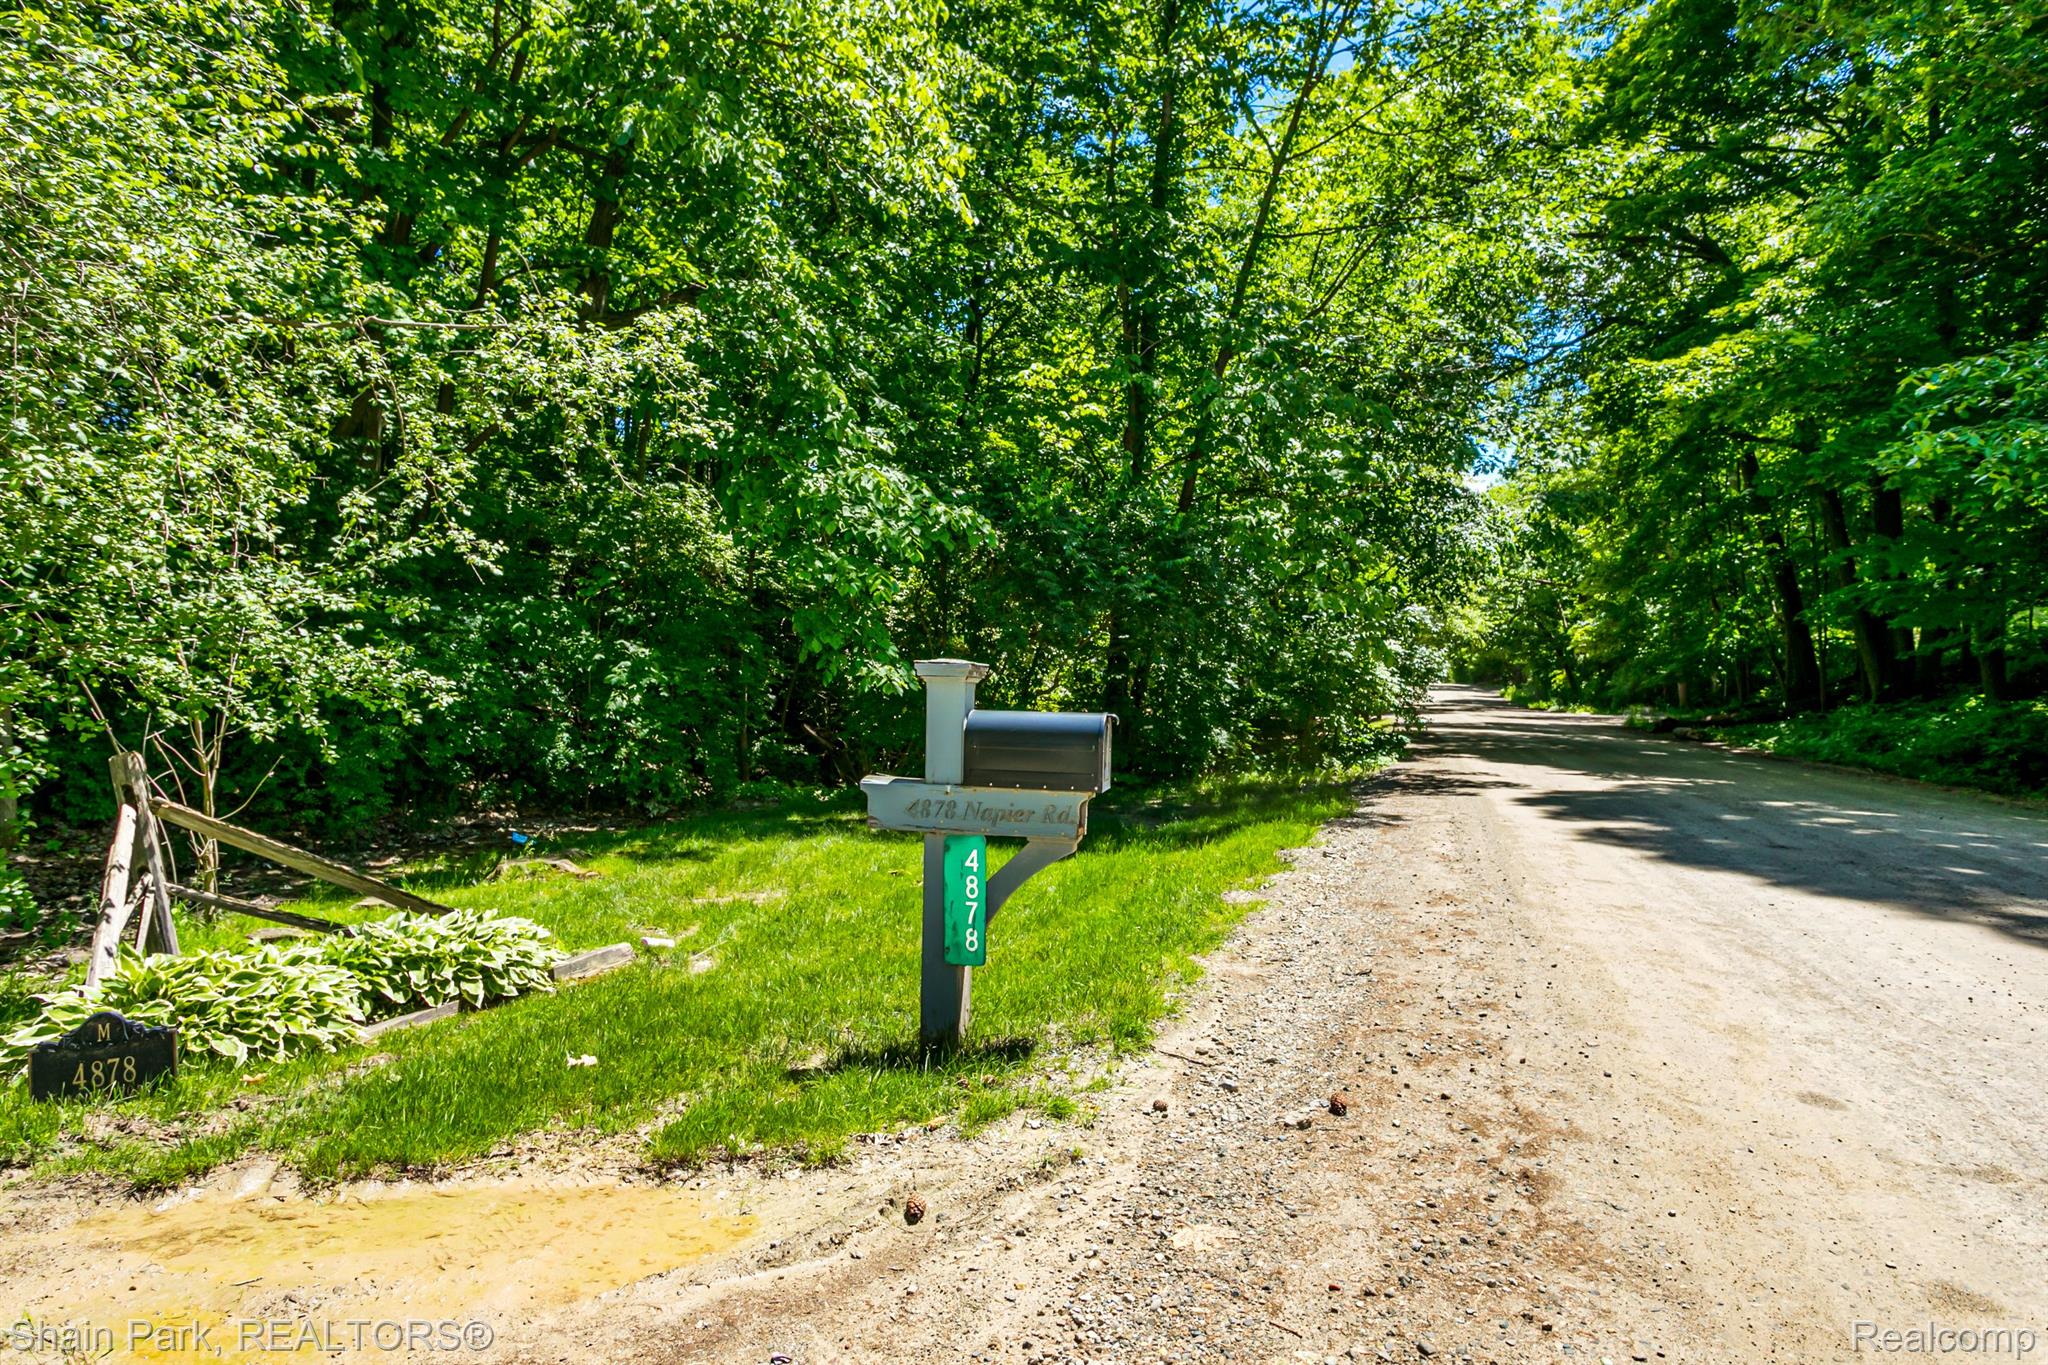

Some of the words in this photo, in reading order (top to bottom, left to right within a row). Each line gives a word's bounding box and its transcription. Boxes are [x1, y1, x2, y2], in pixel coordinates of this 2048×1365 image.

[904, 798, 957, 821] 4878
[960, 801, 1036, 827] Napier
[1040, 804, 1076, 825] Rd.
[964, 848, 980, 953] 4878
[97, 1022, 111, 1043] M
[72, 1055, 137, 1088] 4878
